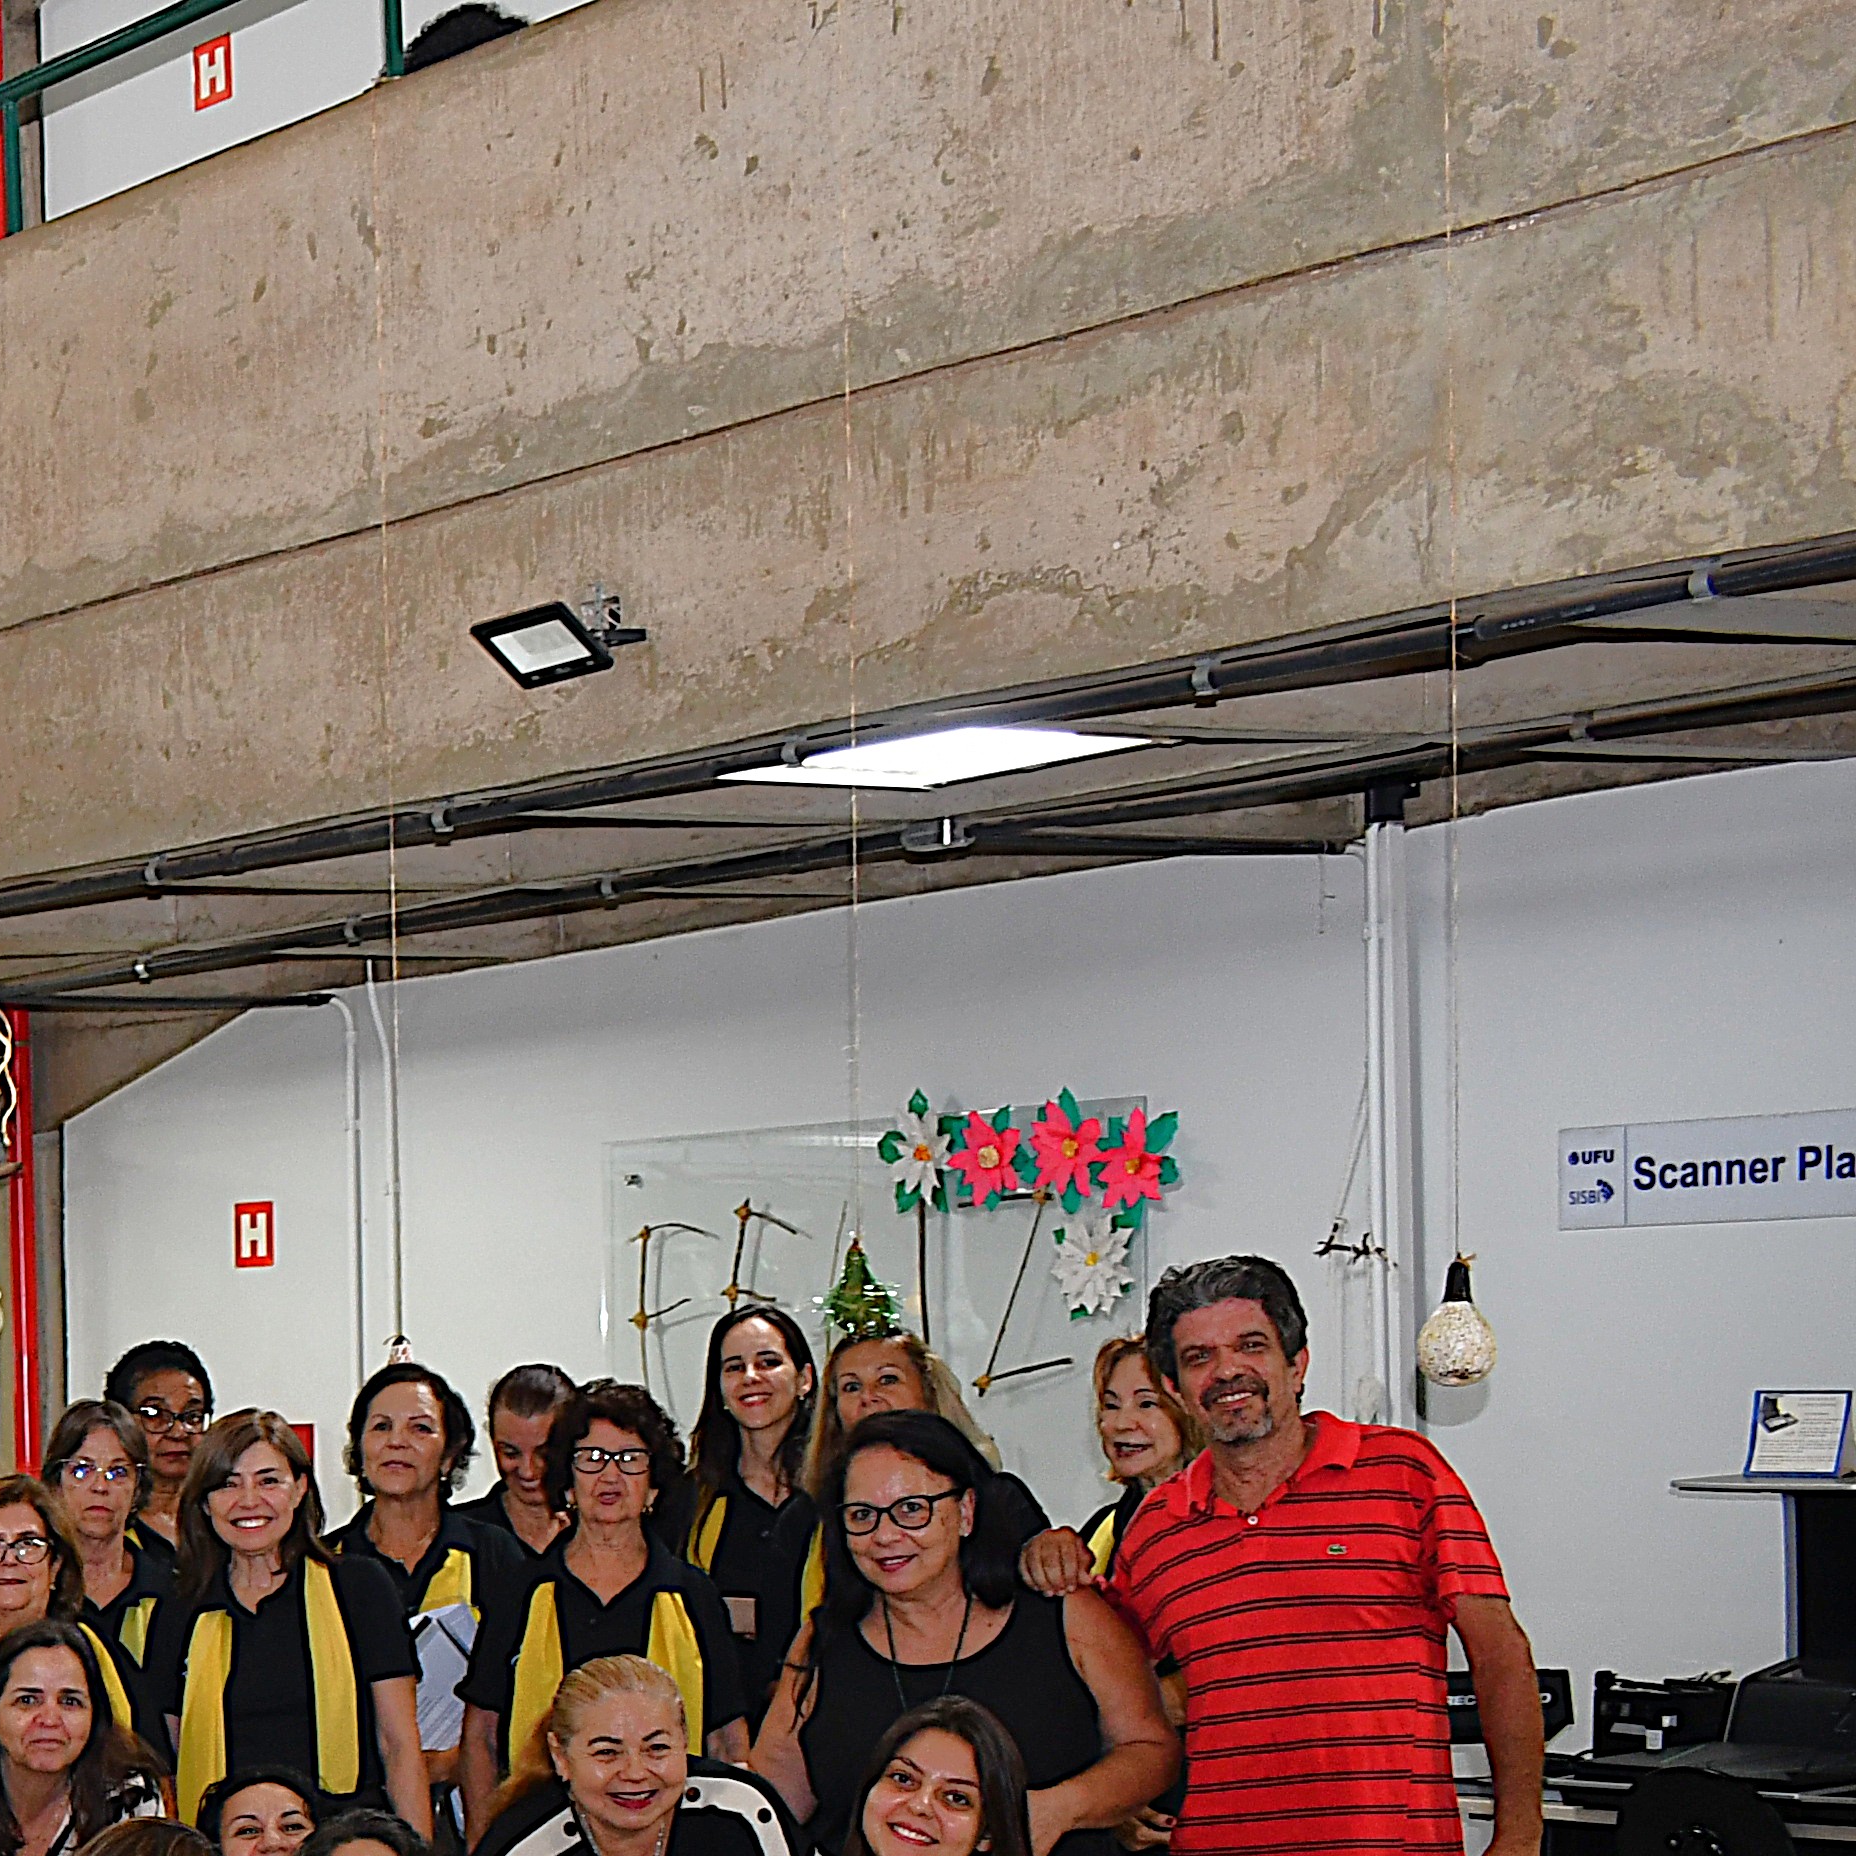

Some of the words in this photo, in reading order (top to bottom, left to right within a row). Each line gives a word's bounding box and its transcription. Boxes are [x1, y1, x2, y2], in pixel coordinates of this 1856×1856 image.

[199, 45, 226, 99] H
[1581, 1150, 1614, 1163] UFU
[1633, 1156, 1786, 1191] Scanner
[1568, 1191, 1600, 1205] SISBI
[240, 1213, 268, 1257] H
